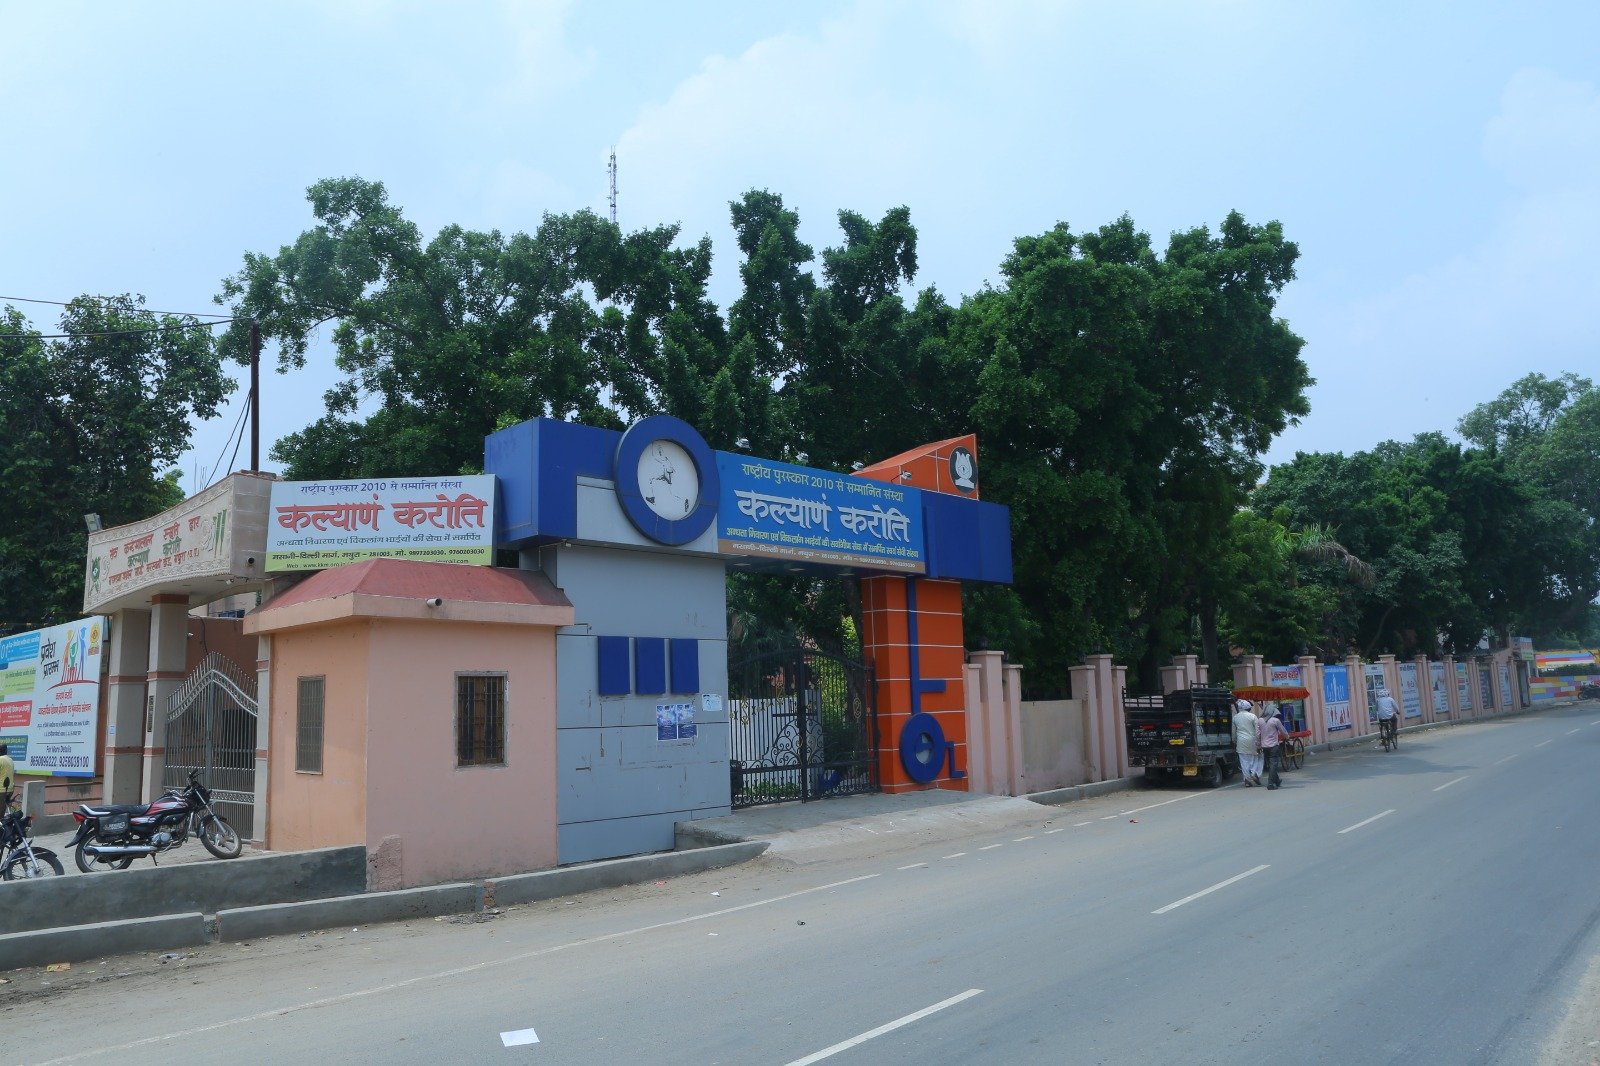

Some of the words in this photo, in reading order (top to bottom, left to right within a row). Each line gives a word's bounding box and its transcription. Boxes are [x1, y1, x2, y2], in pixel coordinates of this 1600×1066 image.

[301, 484, 327, 495] राष्ट्रीय
[329, 484, 358, 495] पुरस्कार
[360, 482, 386, 492] 2010
[391, 481, 398, 490] से
[400, 480, 438, 490] सम्मानित
[440, 480, 462, 489] संस्था
[742, 464, 771, 479] राष्ट्रीय
[773, 470, 809, 485] पुरस्कार
[812, 476, 833, 490] 2010
[836, 479, 844, 491] से
[846, 484, 881, 498] सम्मानित
[883, 489, 903, 502] संस्था
[276, 493, 385, 533] कल्याणं
[391, 493, 488, 529] करोति
[734, 490, 832, 532] कल्याणं
[836, 504, 910, 542] करोति
[305, 536, 335, 545] निवारण
[336, 538, 349, 546] एवं
[350, 536, 383, 544] विकलांग
[41, 638, 56, 664] प्रवेश
